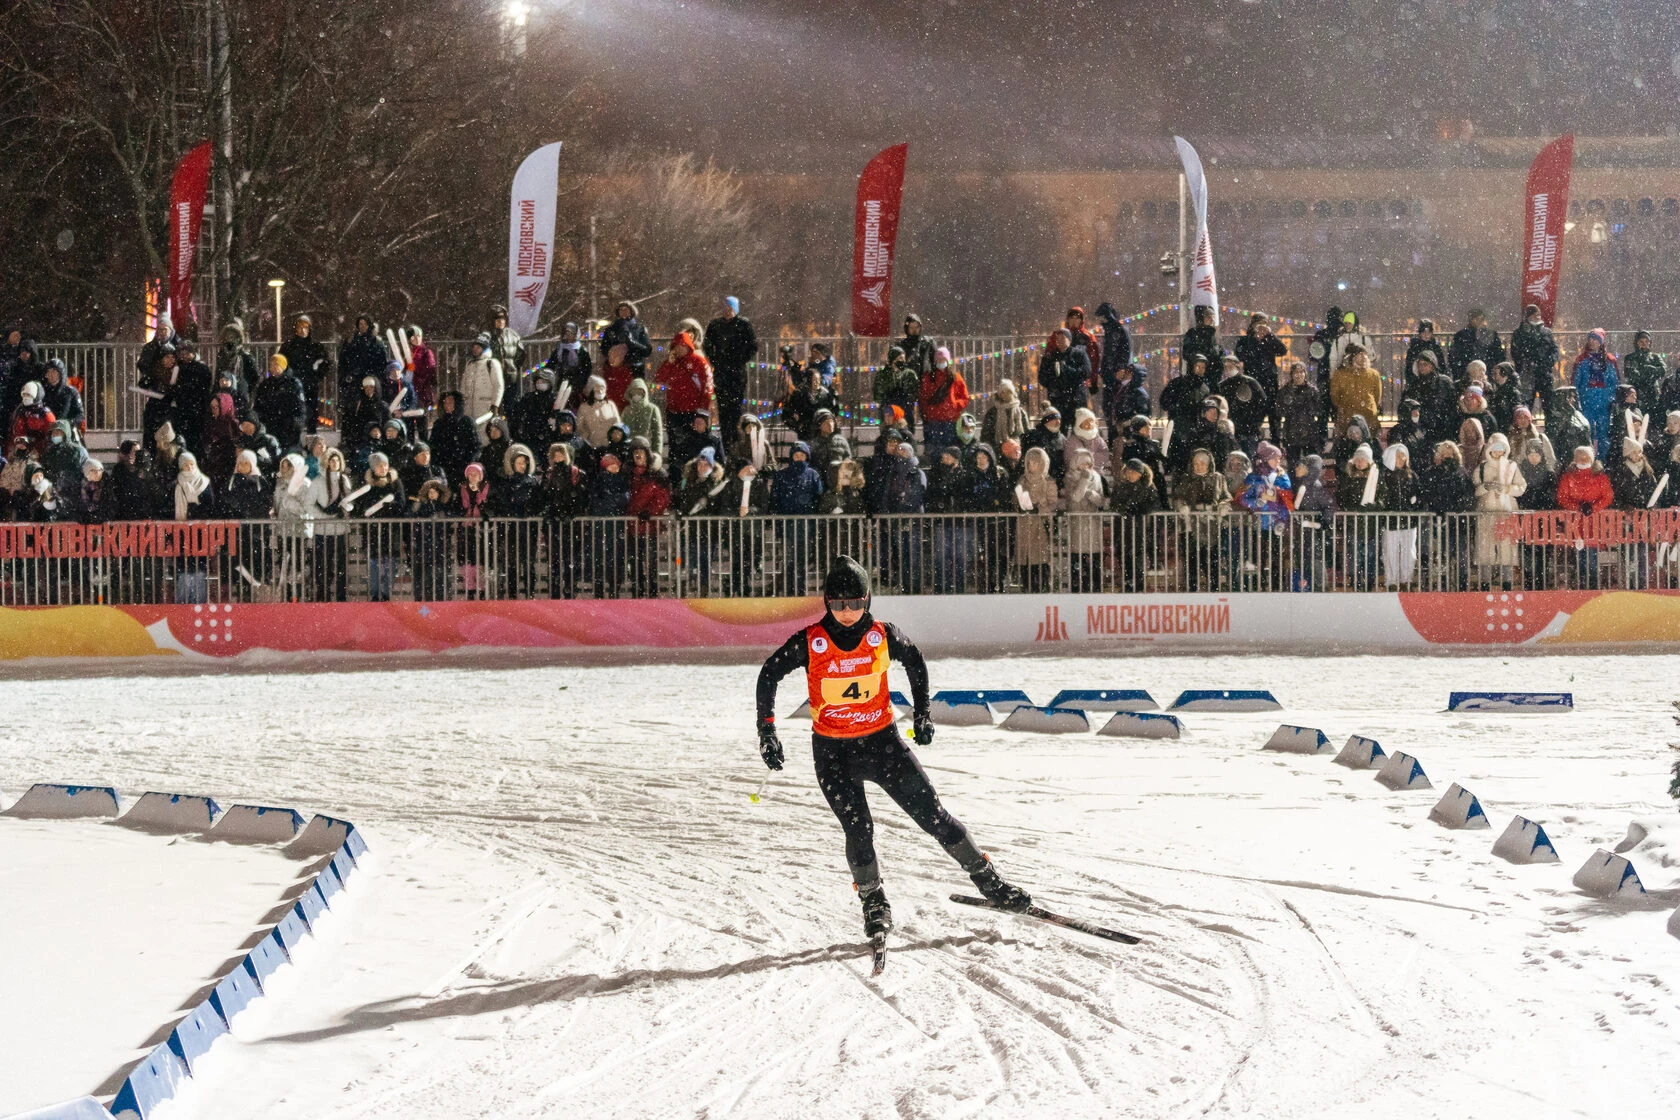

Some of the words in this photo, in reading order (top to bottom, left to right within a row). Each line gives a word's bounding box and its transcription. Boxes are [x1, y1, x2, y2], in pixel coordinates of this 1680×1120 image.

[517, 200, 535, 276] МОСКОВСКИЙ
[863, 200, 881, 277] МОСКОВСКИЙ
[1528, 194, 1548, 270] МОСКОВСКИЙ
[532, 241, 547, 277] СПОРТ
[876, 241, 889, 277] СПОРТ
[1543, 234, 1558, 270] СПОРТ
[1087, 598, 1230, 634] МОСКОВСКИЙ
[842, 682, 861, 700] 4
[864, 690, 870, 699] 1
